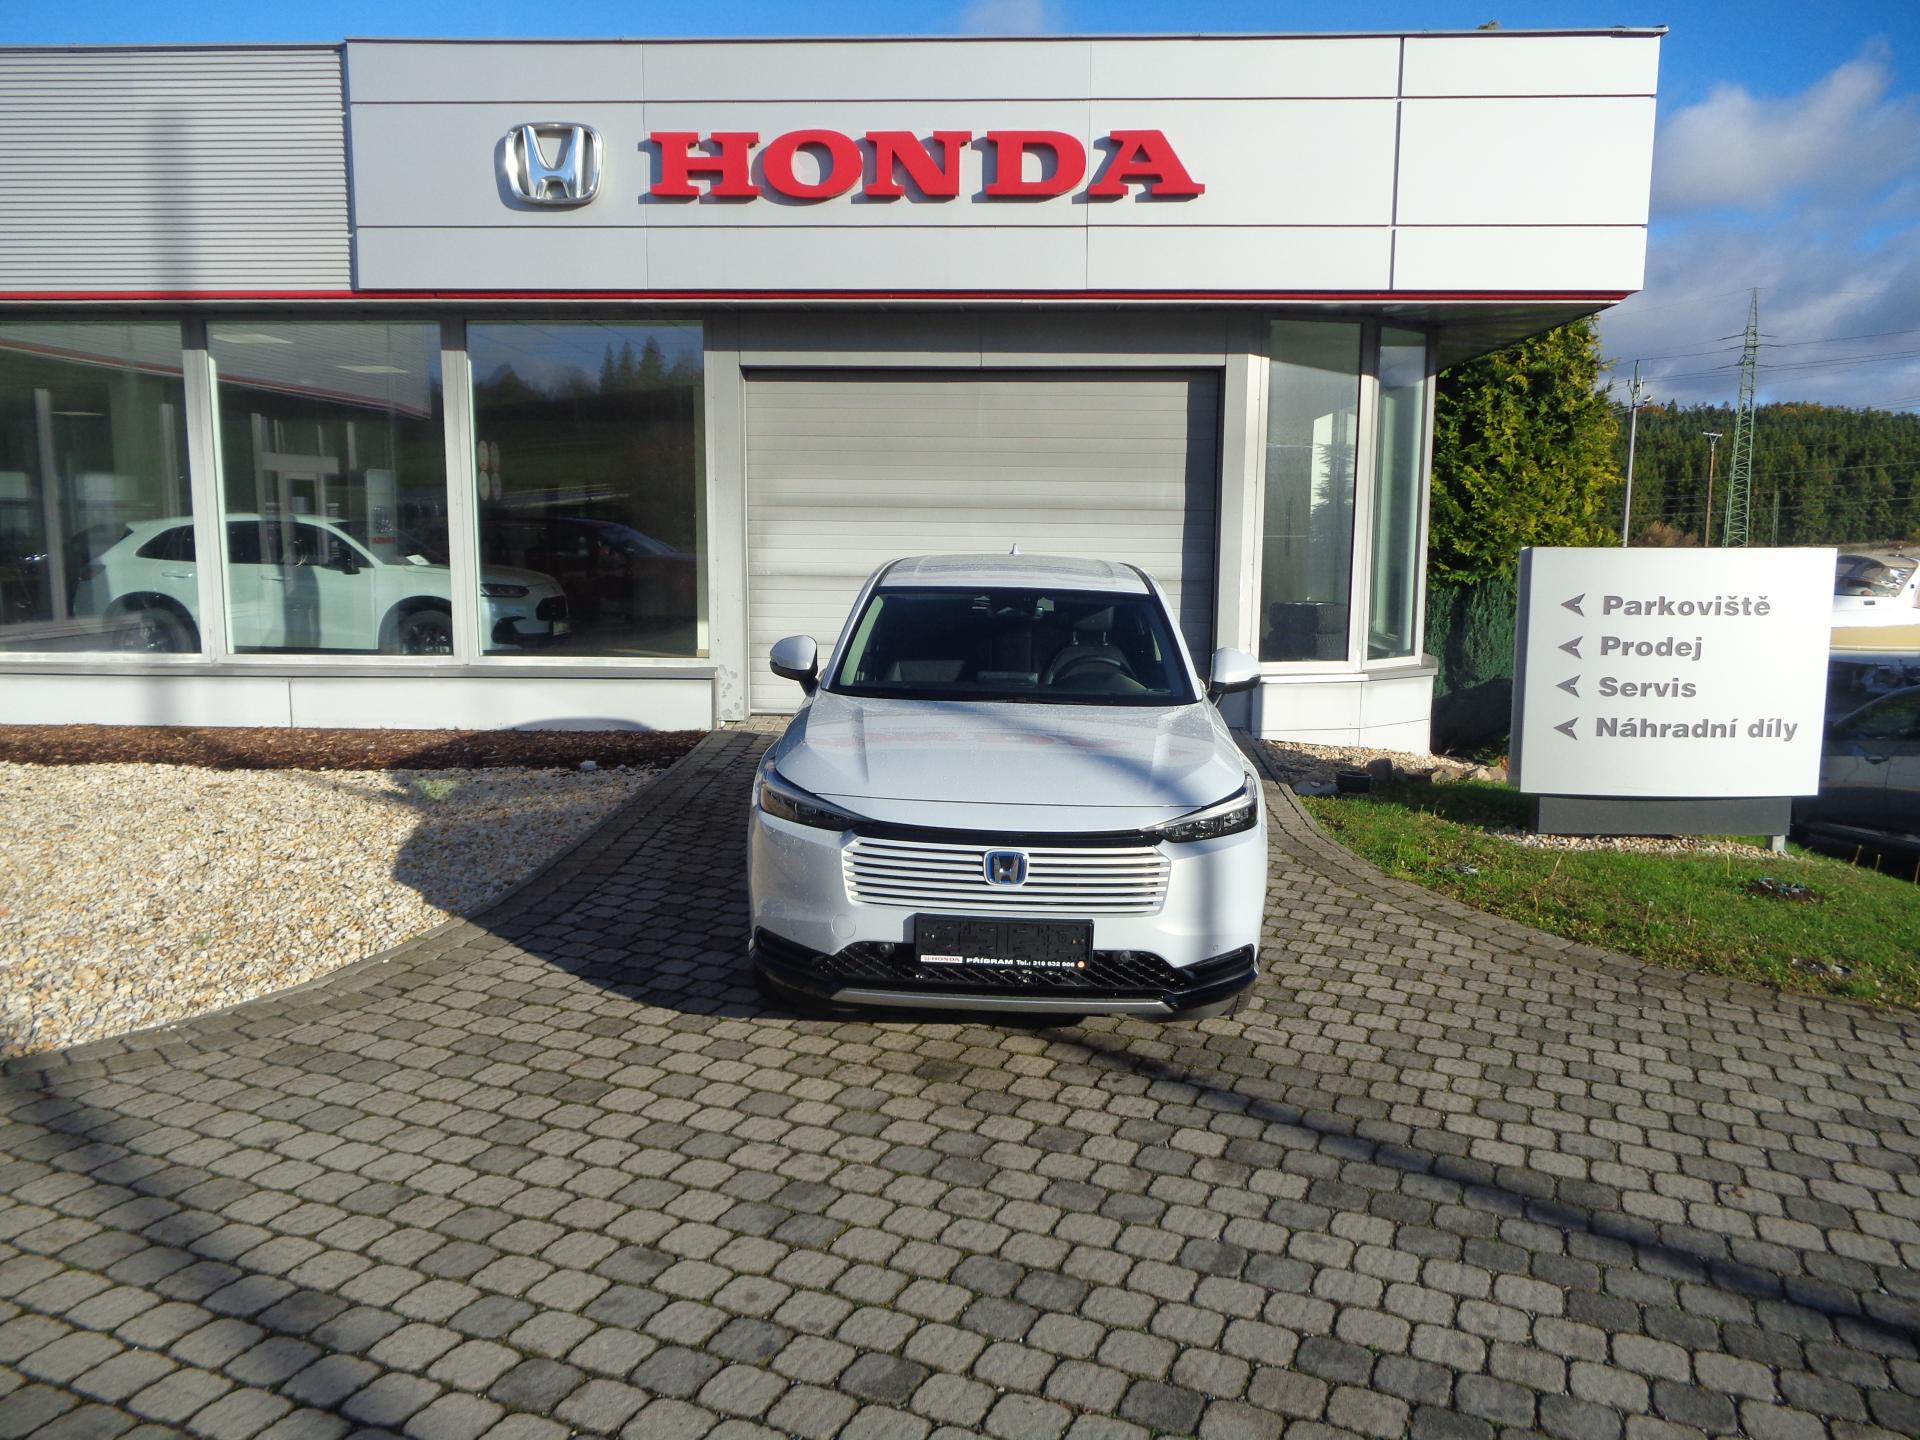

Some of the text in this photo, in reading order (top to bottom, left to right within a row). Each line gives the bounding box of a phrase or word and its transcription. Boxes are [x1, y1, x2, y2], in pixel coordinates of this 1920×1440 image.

[650, 128, 1206, 200] HONDA
[1602, 595, 1771, 617] Parkoviště
[1600, 636, 1703, 661] Prodej
[1598, 676, 1697, 698] Servis
[1595, 717, 1799, 742] Náhradní díly
